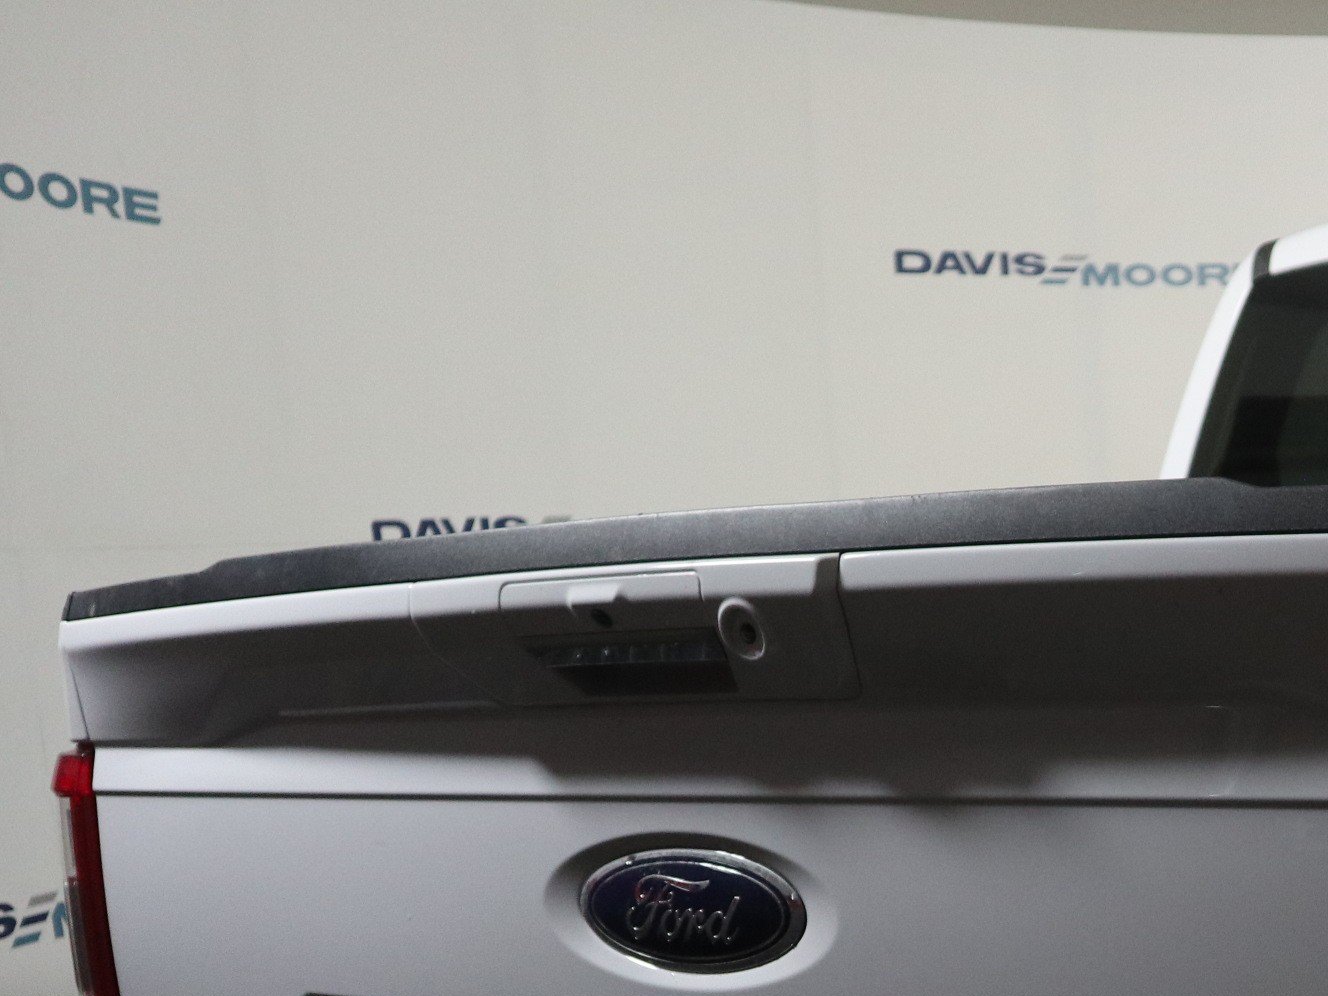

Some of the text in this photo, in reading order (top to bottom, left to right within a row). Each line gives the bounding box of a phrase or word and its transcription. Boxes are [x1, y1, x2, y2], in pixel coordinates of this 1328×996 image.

[894, 249, 1241, 287] DAVIS MOOR
[625, 872, 741, 945] Ford
